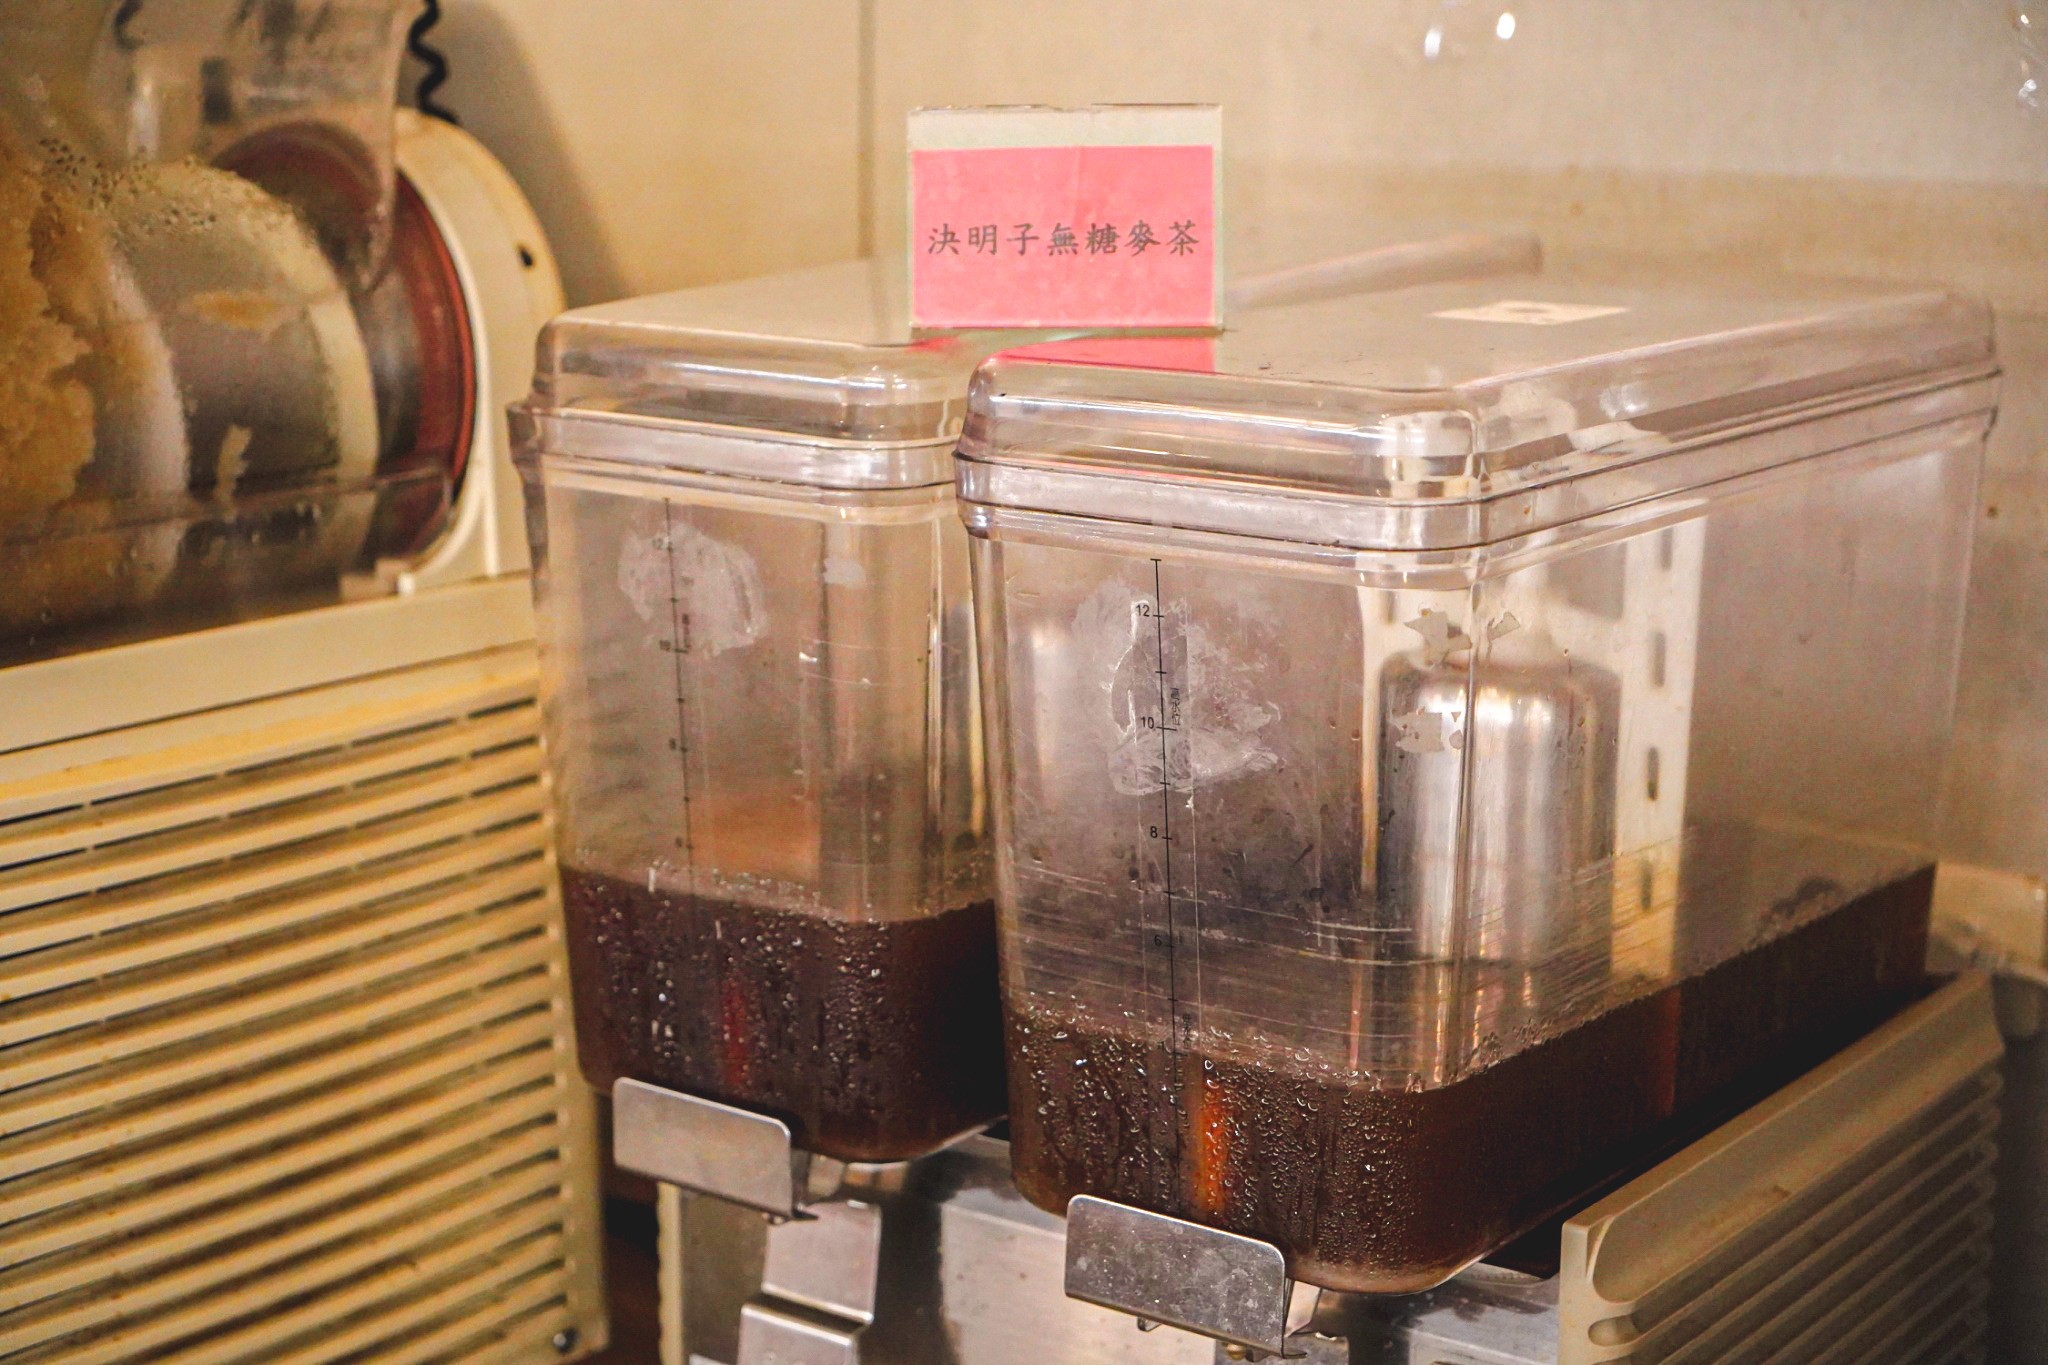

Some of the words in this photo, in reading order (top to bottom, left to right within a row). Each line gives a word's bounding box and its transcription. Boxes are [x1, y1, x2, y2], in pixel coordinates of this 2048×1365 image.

[927, 218, 1200, 257] 決明子無糖麥茶
[1135, 604, 1151, 617] 12
[1141, 716, 1155, 729] 10
[1150, 825, 1158, 839] 8
[1154, 934, 1163, 946] 6
